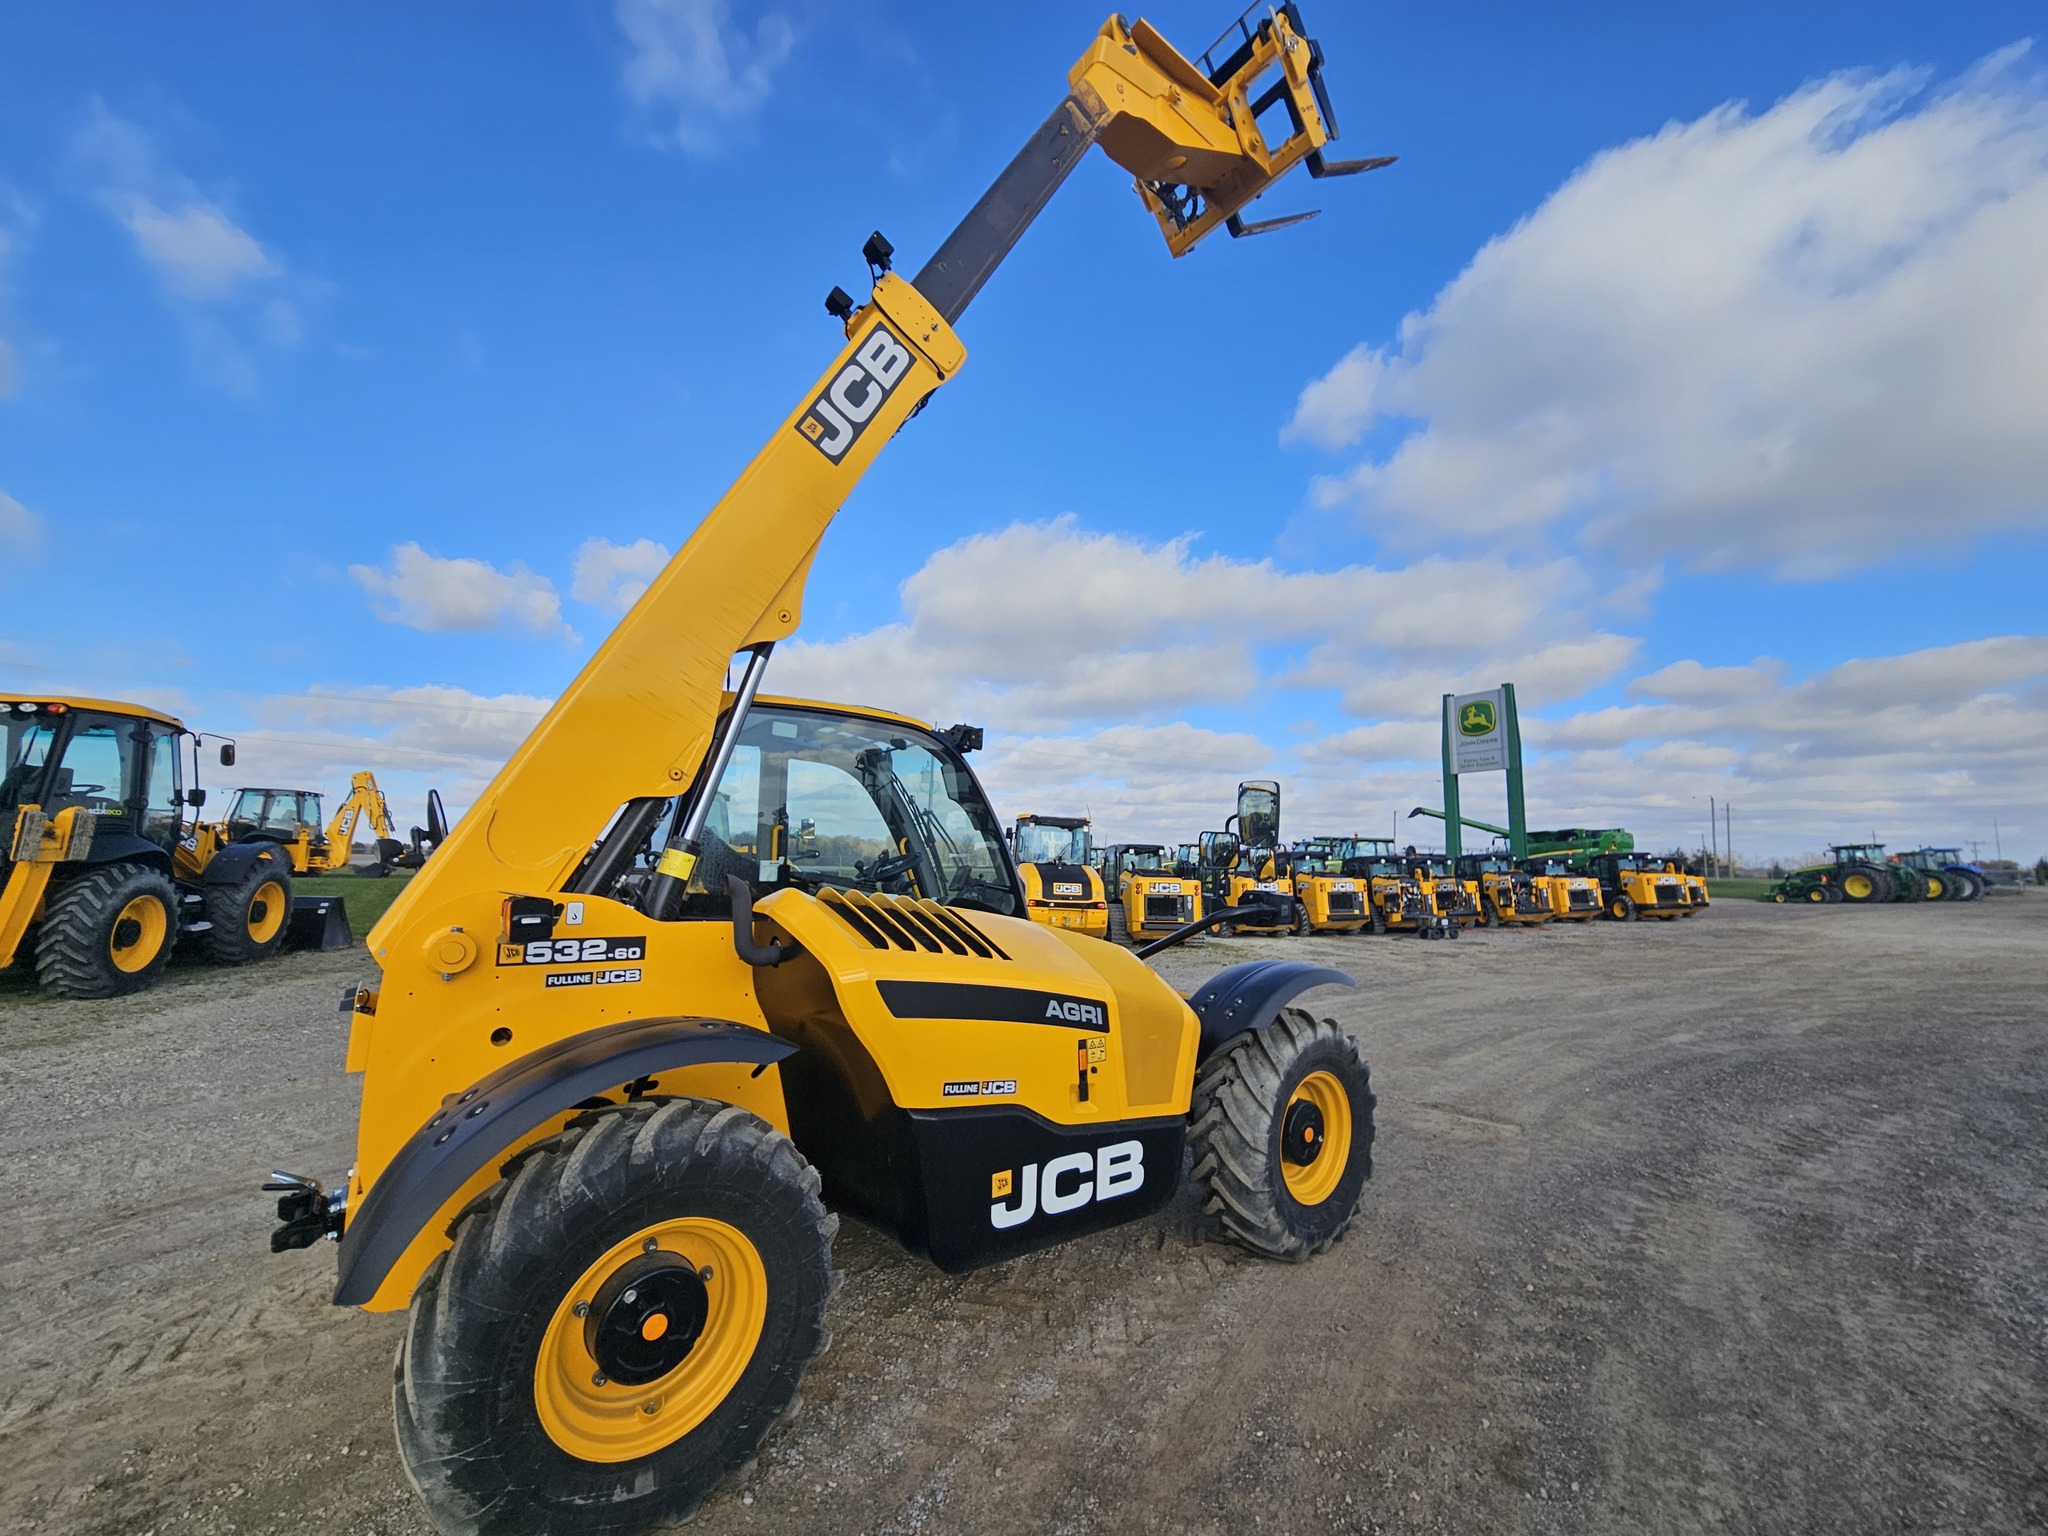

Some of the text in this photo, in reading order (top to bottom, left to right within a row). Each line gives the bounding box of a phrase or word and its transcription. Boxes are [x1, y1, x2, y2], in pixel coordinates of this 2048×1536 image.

[816, 331, 909, 455] JCB
[180, 832, 198, 852] CB
[1056, 884, 1080, 893] JCB
[1150, 882, 1181, 893] JCB
[1255, 882, 1279, 892] JCB
[1332, 882, 1355, 892] JCB
[525, 939, 641, 963] 532-60
[547, 969, 641, 986] FULLINE JCB
[1045, 1000, 1103, 1025] AGRI
[944, 1081, 1016, 1095] FULLINE JCB
[991, 1140, 1145, 1229] JCB
